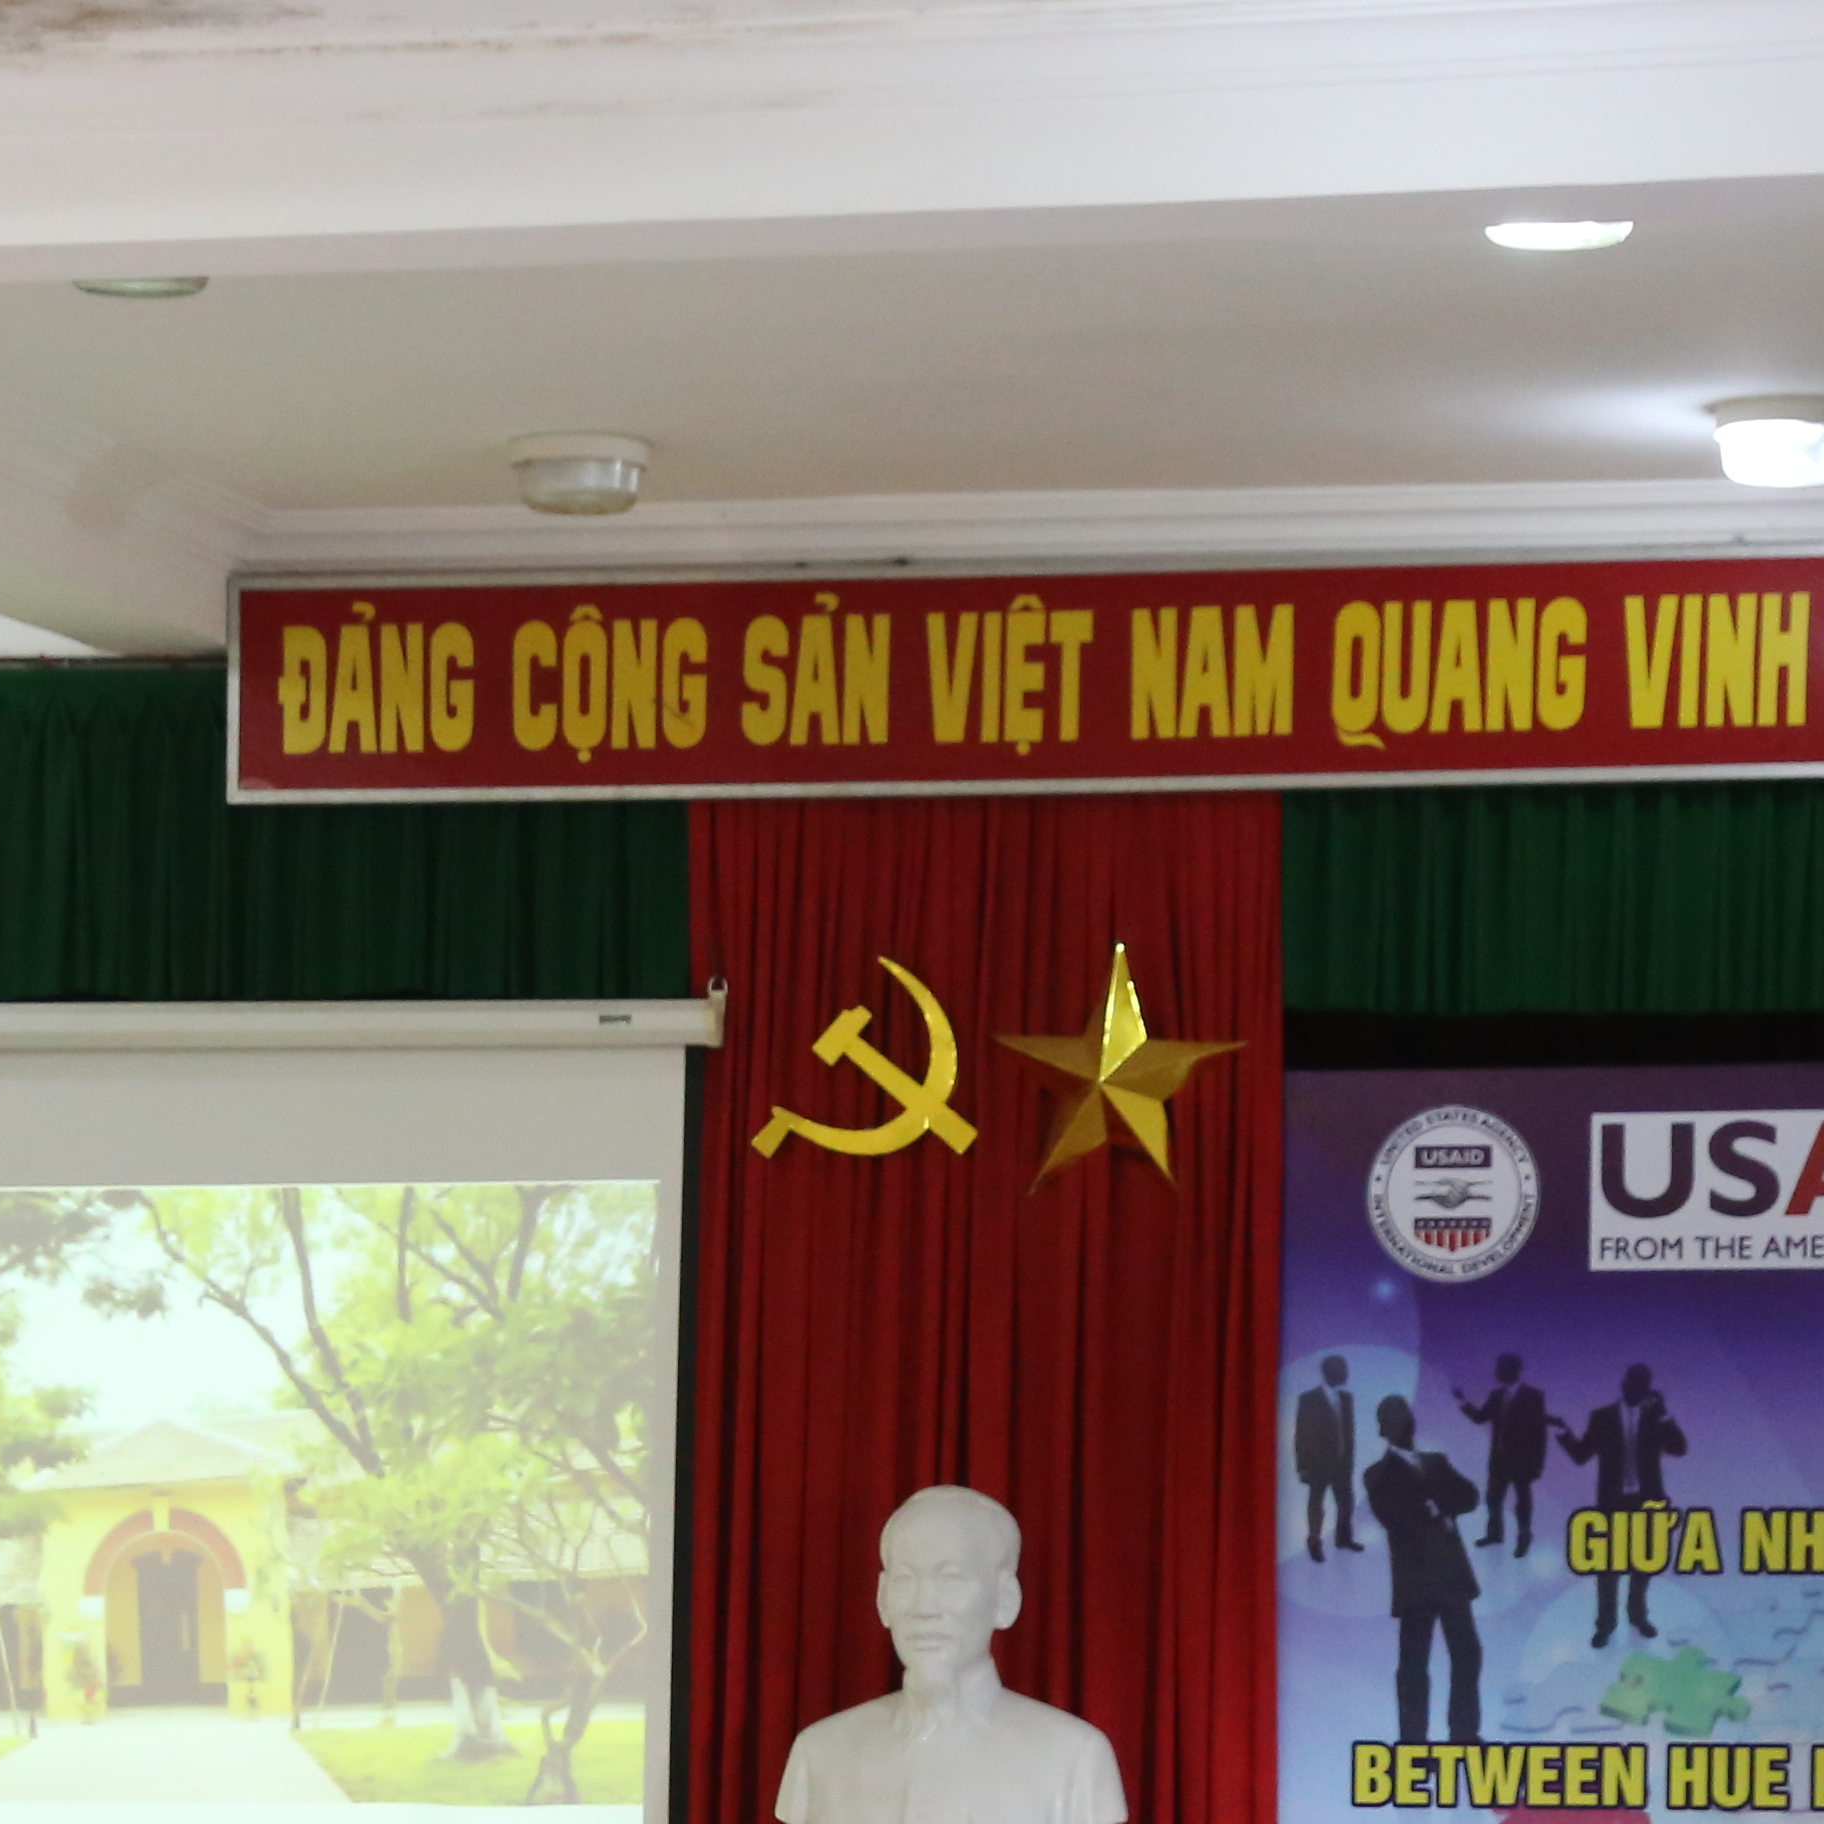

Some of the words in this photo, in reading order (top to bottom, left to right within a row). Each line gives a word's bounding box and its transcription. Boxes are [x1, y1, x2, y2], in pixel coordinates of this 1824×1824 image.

[277, 602, 475, 754] ĐẢNG
[512, 605, 708, 762] CỘNG
[741, 592, 891, 746] SẢN
[926, 594, 1093, 754] VIỆT
[1131, 603, 1295, 740] NAM
[1331, 597, 1588, 748] QUANG
[1623, 591, 1811, 729] VINH
[1420, 1149, 1485, 1166] USAID
[1599, 1236, 1683, 1261] FROM
[1695, 1235, 1752, 1261] THE
[1568, 1498, 1721, 1574] GIỮA
[1352, 1742, 1647, 1808] BETWEEN
[1667, 1744, 1790, 1809] HUE
